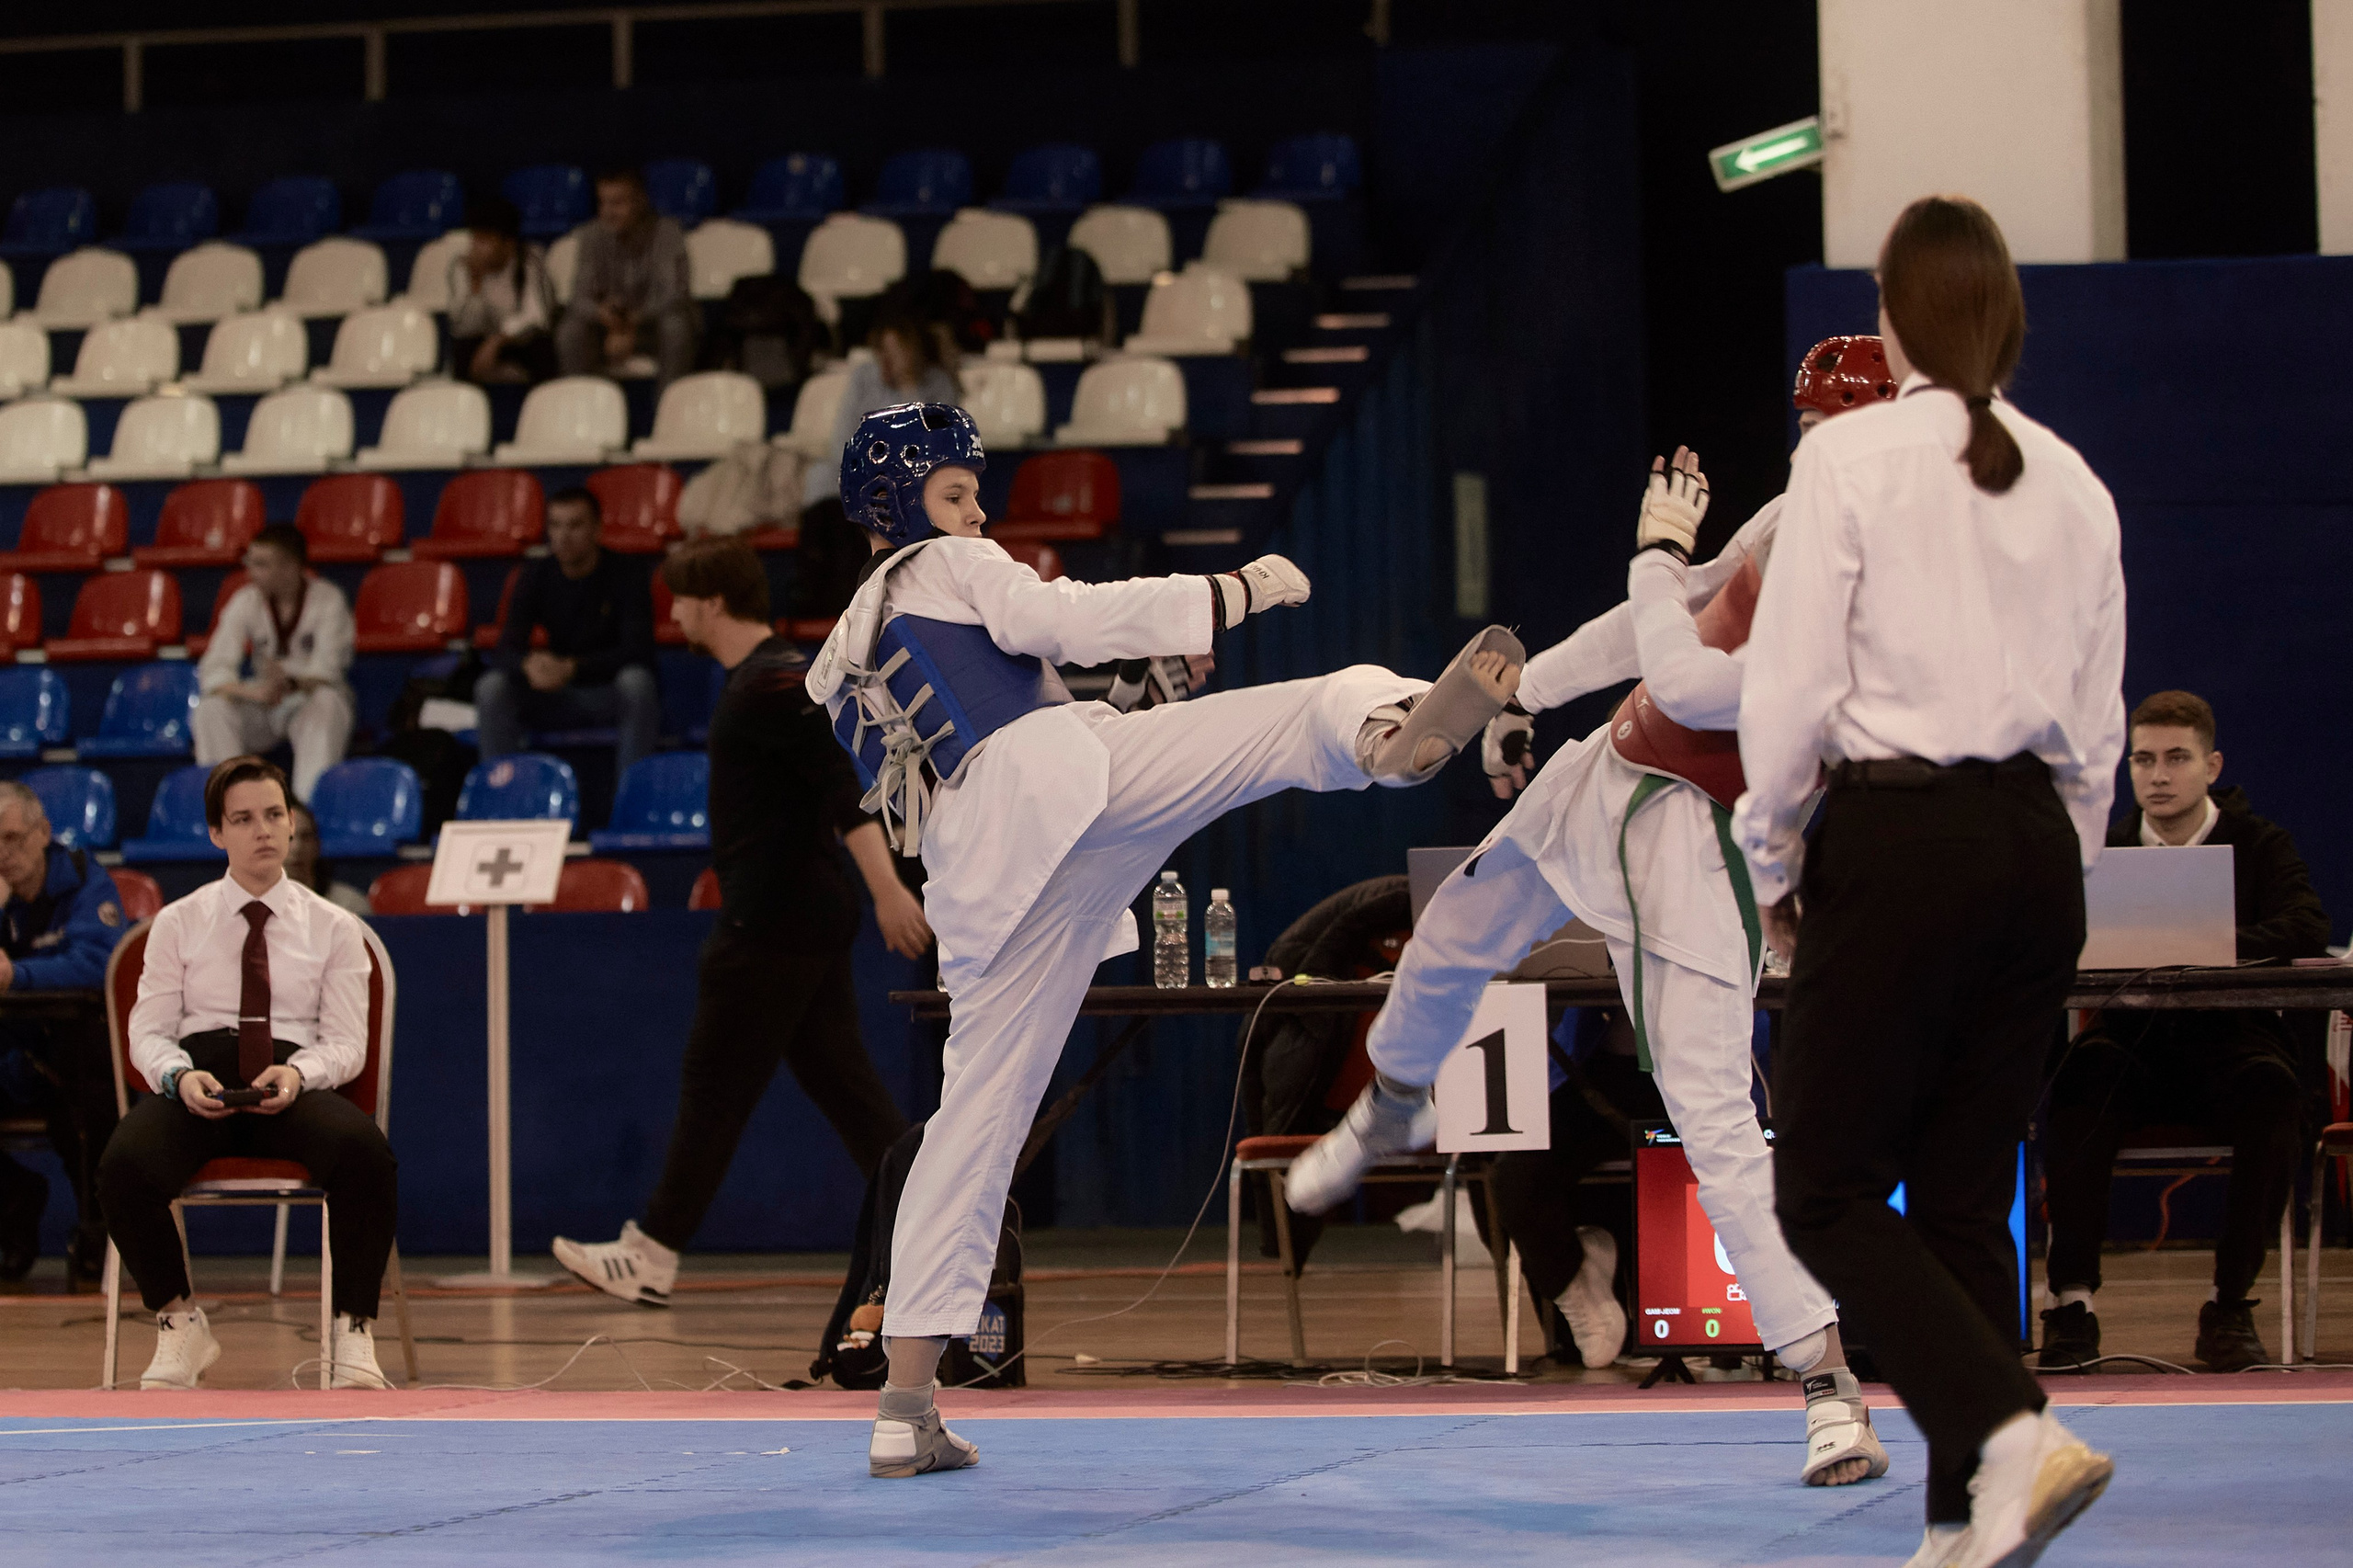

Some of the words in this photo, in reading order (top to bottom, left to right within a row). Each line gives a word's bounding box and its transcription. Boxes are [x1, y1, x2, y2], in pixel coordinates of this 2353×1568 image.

[1465, 1028, 1523, 1135] 1
[159, 1315, 175, 1331] K
[349, 1316, 365, 1334] K
[976, 1315, 1005, 1333] KAT
[1654, 1320, 1669, 1338] 0
[1705, 1319, 1720, 1337] 0
[969, 1335, 1006, 1353] 2023
